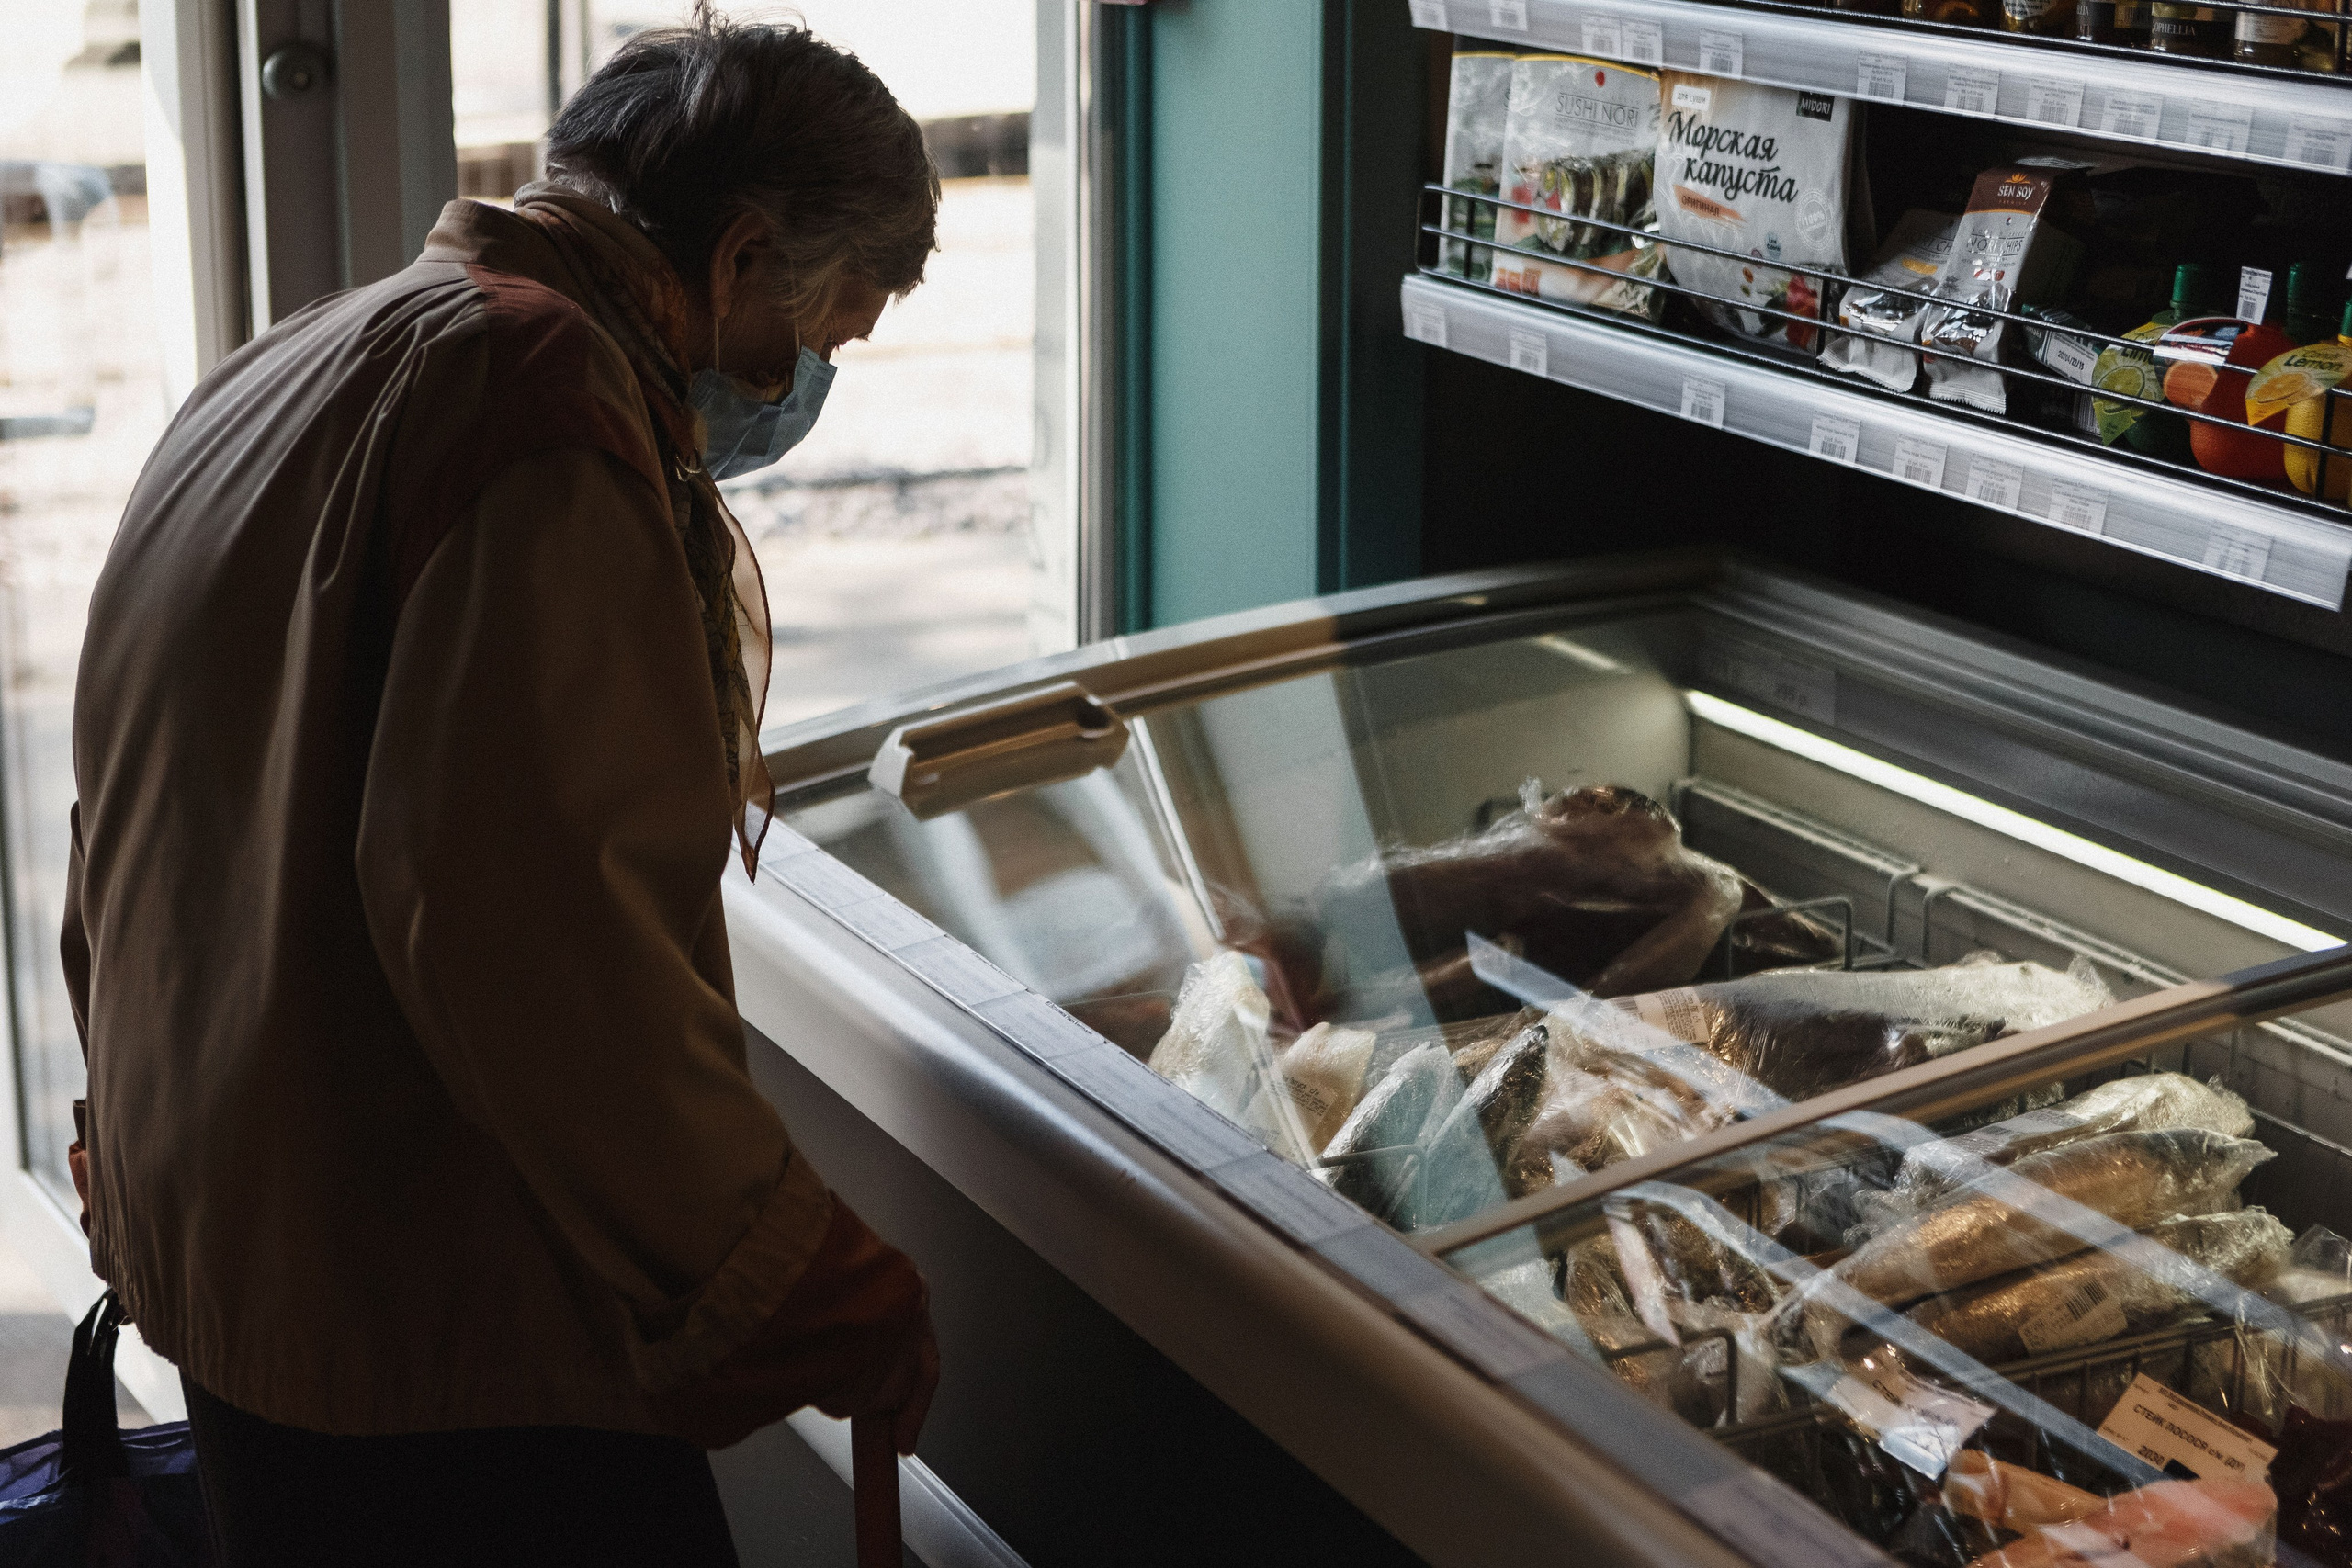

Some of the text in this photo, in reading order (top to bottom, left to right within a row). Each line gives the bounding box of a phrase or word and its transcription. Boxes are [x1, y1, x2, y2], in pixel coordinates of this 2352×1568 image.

[1555, 95, 1598, 120] SUSHI
[1601, 105, 1639, 128] NORI
[1800, 97, 1831, 115] MIDORI
[1668, 111, 1779, 162] Морская
[1683, 157, 1799, 204] капуста
[1997, 185, 2034, 202] SEN SOY
[1680, 194, 1720, 218] ОРИГИНАЛ
[1967, 237, 1997, 254] NORI
[2283, 355, 2344, 371] Lemon
[2132, 1404, 2165, 1427] СТЕЙК
[2165, 1422, 2209, 1451] ЛОСОСЯ
